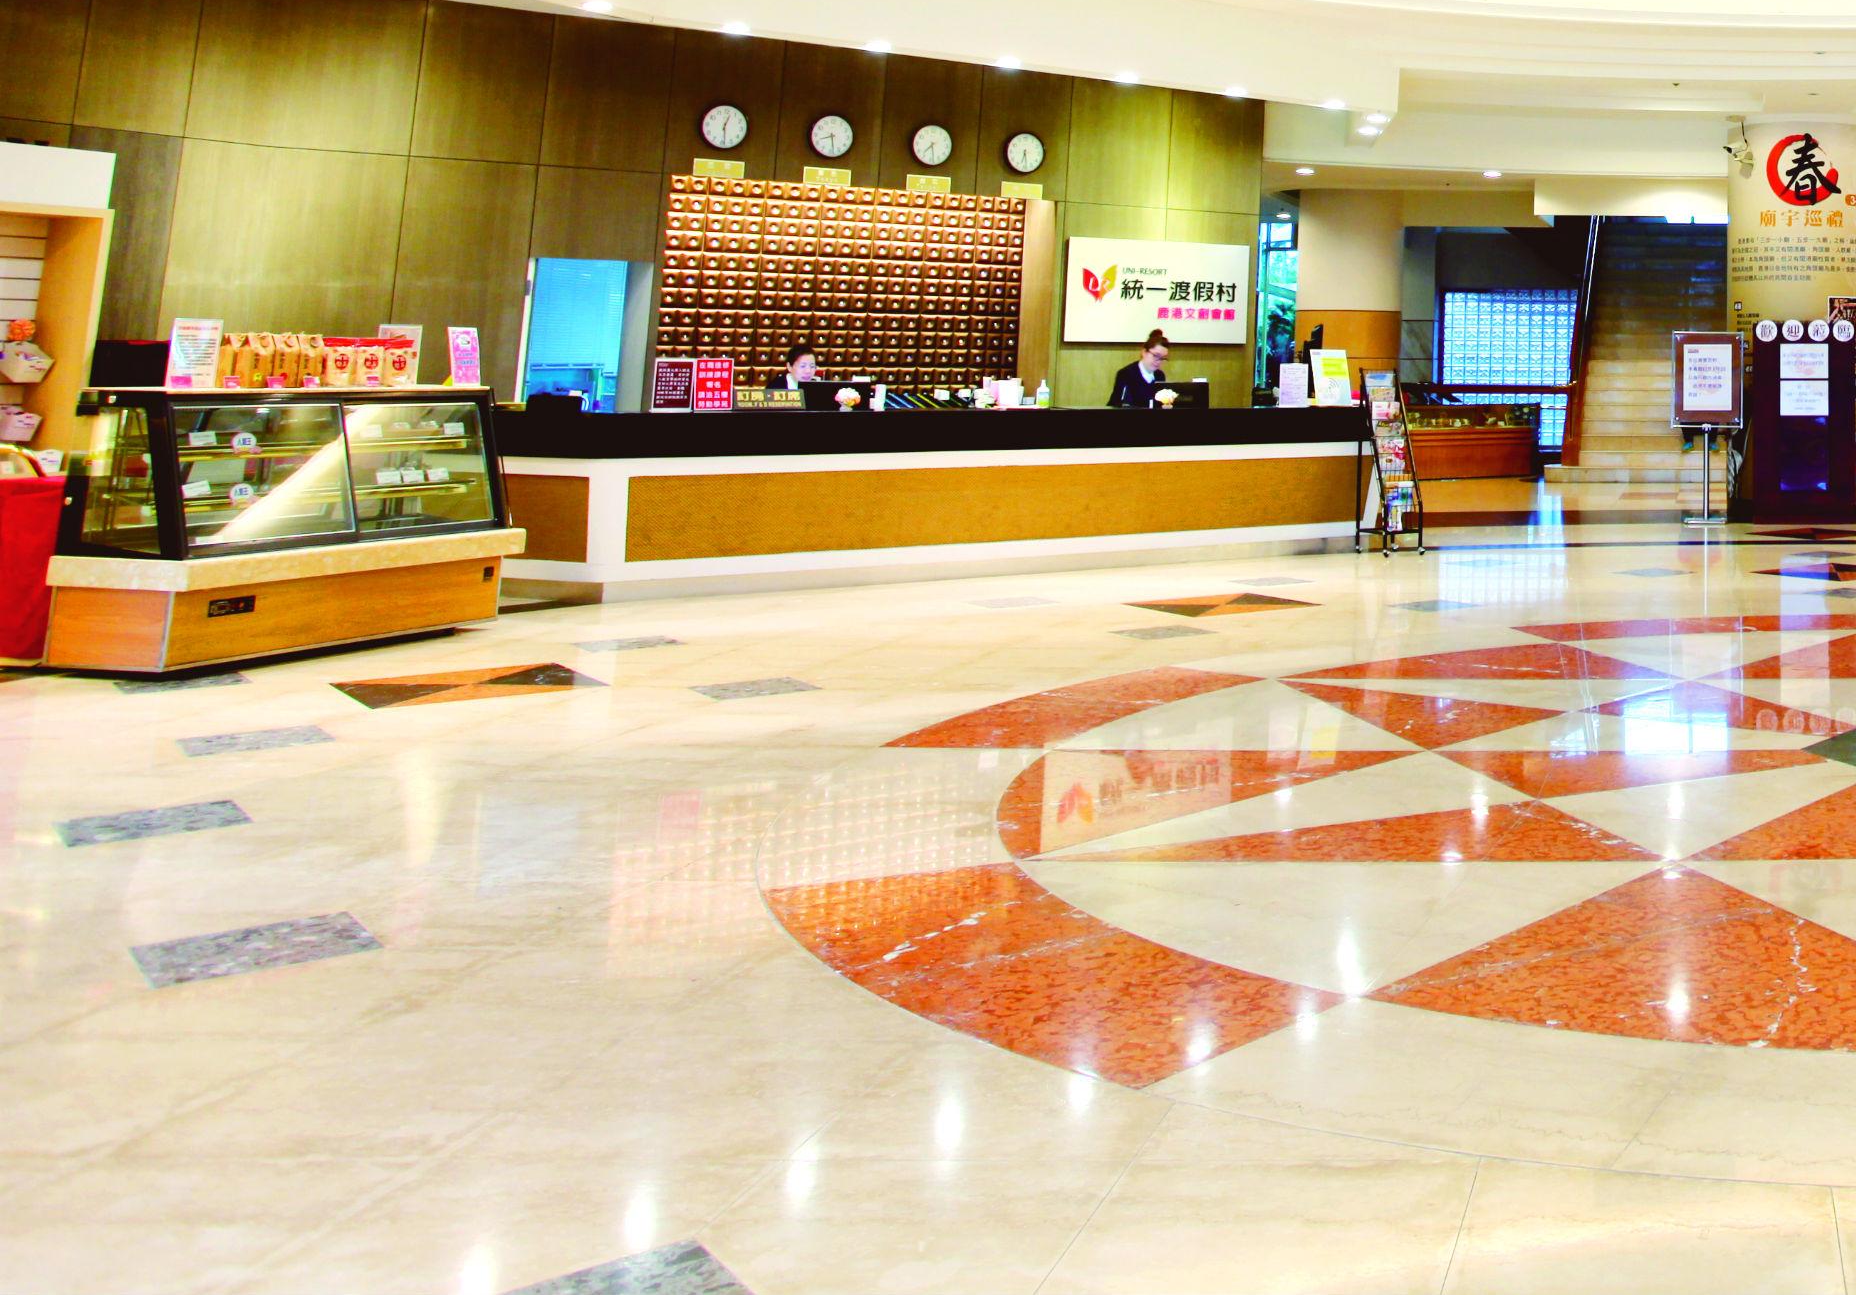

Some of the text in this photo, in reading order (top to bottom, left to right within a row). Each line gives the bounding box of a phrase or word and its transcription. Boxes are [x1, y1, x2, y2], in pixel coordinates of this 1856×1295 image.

[1779, 133, 1842, 206] 春
[1759, 209, 1844, 228] 廟宇巡禮
[1122, 267, 1167, 275] UNI-RESORT
[1120, 279, 1237, 303] 統一渡假村
[1157, 307, 1236, 321] 鹿港文創會館
